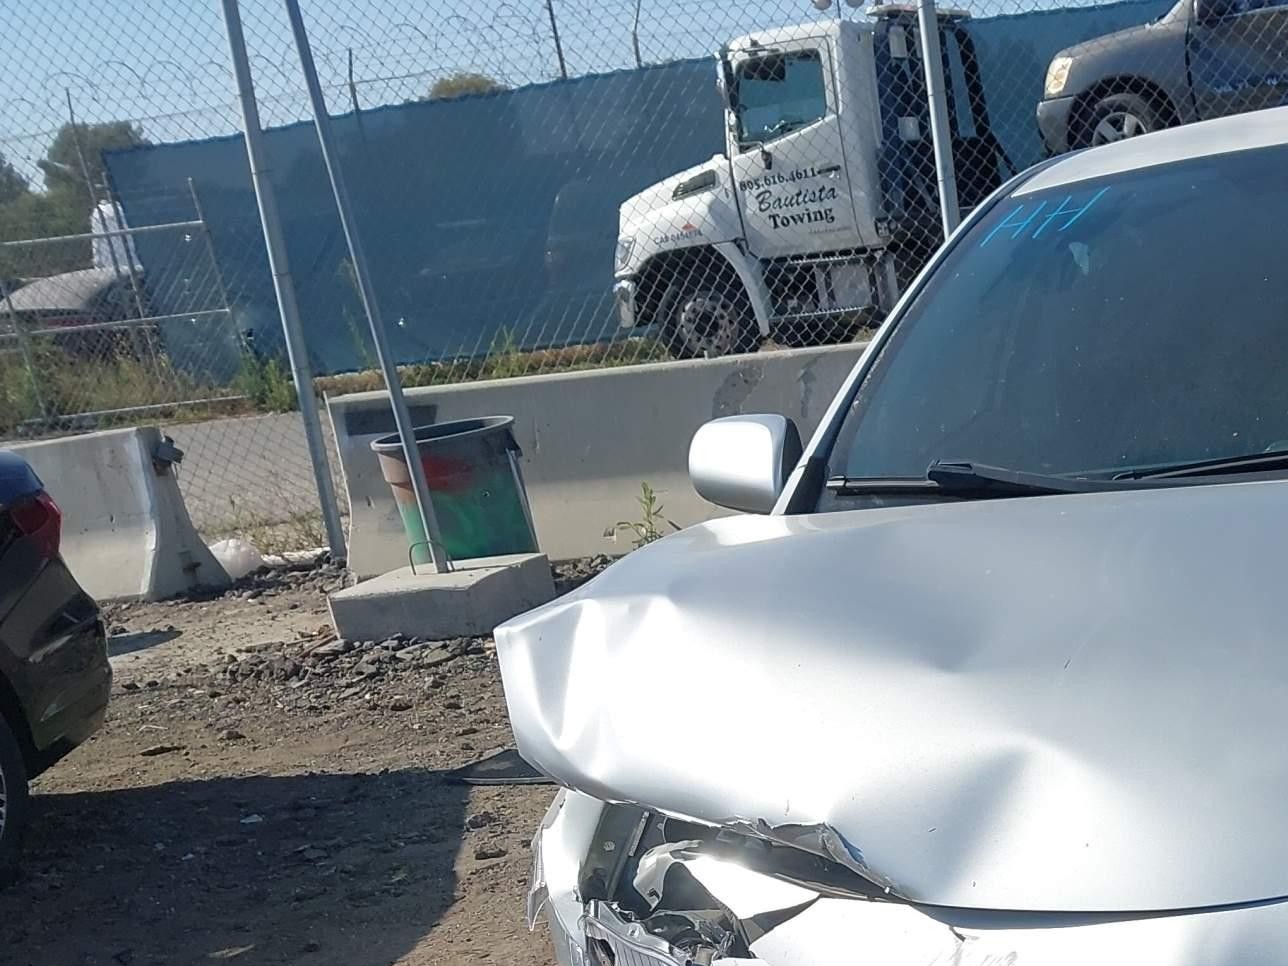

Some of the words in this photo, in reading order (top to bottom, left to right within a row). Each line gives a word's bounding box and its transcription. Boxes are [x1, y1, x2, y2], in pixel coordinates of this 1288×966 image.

[740, 167, 818, 192] 805.616.4611
[755, 184, 838, 213] Bautista
[768, 208, 836, 230] Towing
